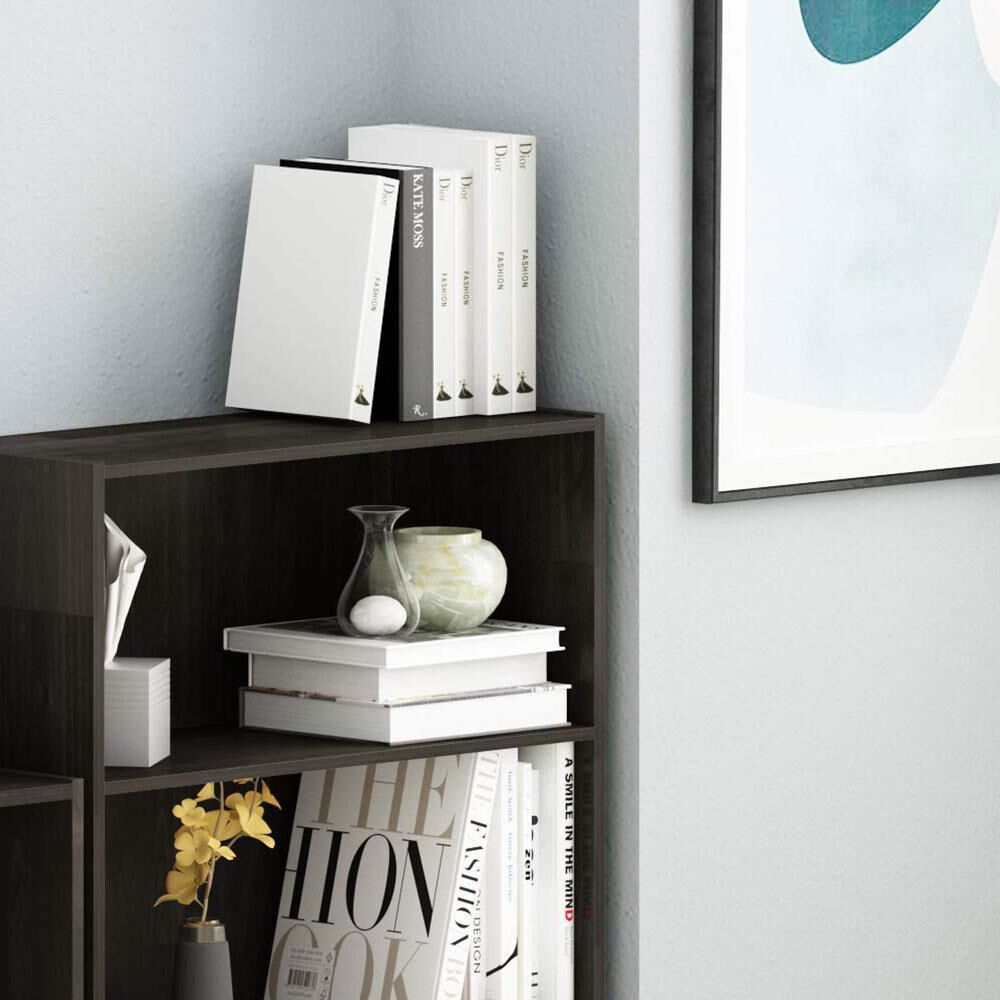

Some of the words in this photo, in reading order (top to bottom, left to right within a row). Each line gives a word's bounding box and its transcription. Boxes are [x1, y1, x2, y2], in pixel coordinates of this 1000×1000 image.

[494, 145, 508, 172] Dior
[519, 143, 533, 170] Dior
[413, 173, 424, 210] KATE
[461, 176, 473, 200] Dior
[413, 213, 424, 248] MOSS
[564, 757, 574, 767] A
[564, 773, 574, 820] SMILE
[564, 825, 574, 841] IN
[564, 847, 574, 875] THE
[564, 880, 574, 922] MIND
[473, 917, 482, 974] DESIGN
